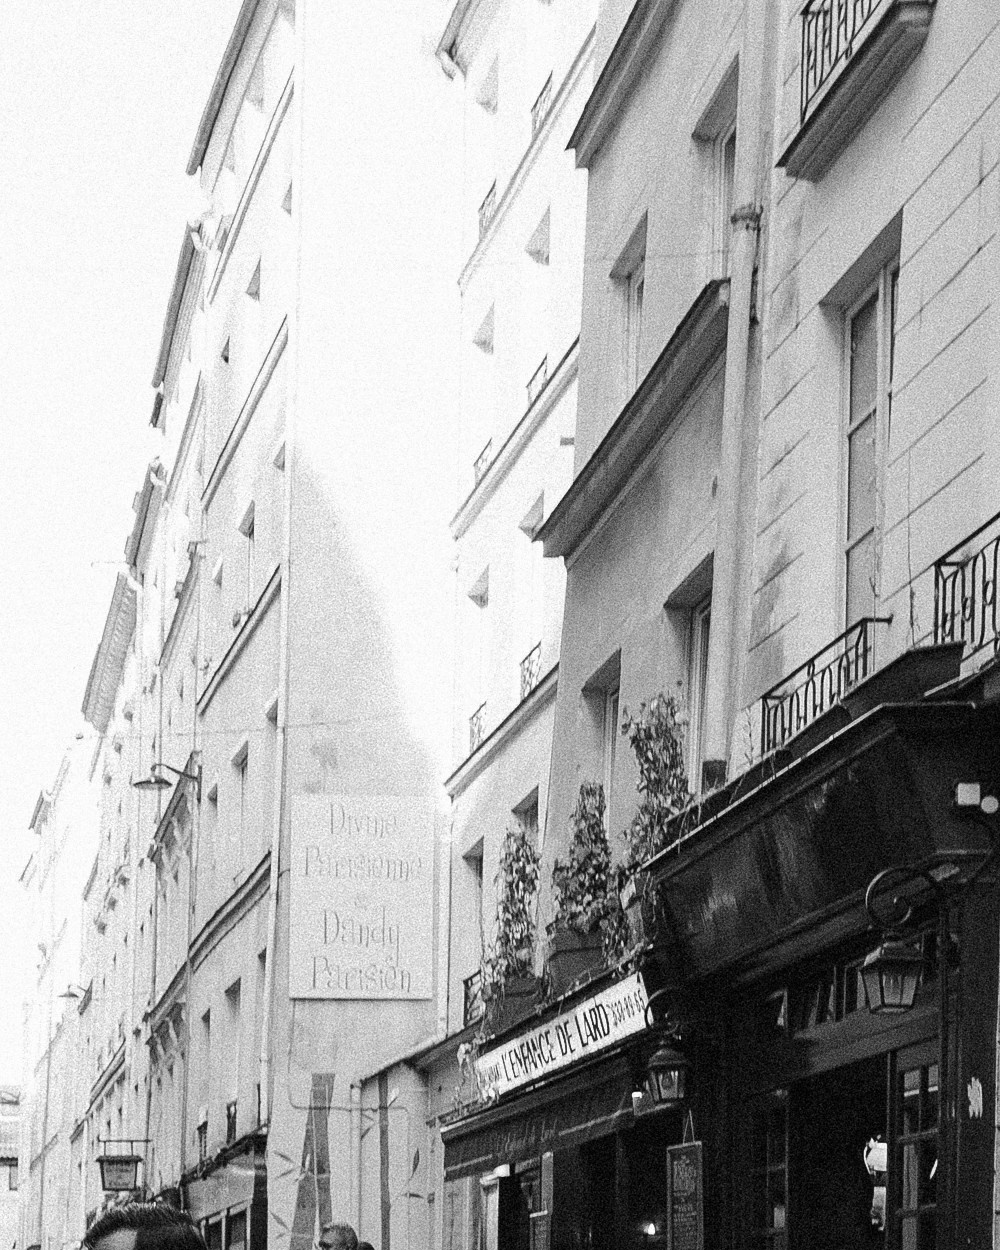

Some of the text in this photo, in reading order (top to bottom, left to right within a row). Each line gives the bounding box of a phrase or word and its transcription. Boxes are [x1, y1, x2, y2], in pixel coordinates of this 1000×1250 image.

[329, 801, 397, 838] Divine
[304, 845, 422, 881] Parisienne
[323, 906, 401, 967] Dandy
[312, 956, 412, 992] Parisien
[501, 1030, 557, 1081] L'ENFANCE
[555, 1019, 576, 1056] DE
[574, 1003, 610, 1048] LARD
